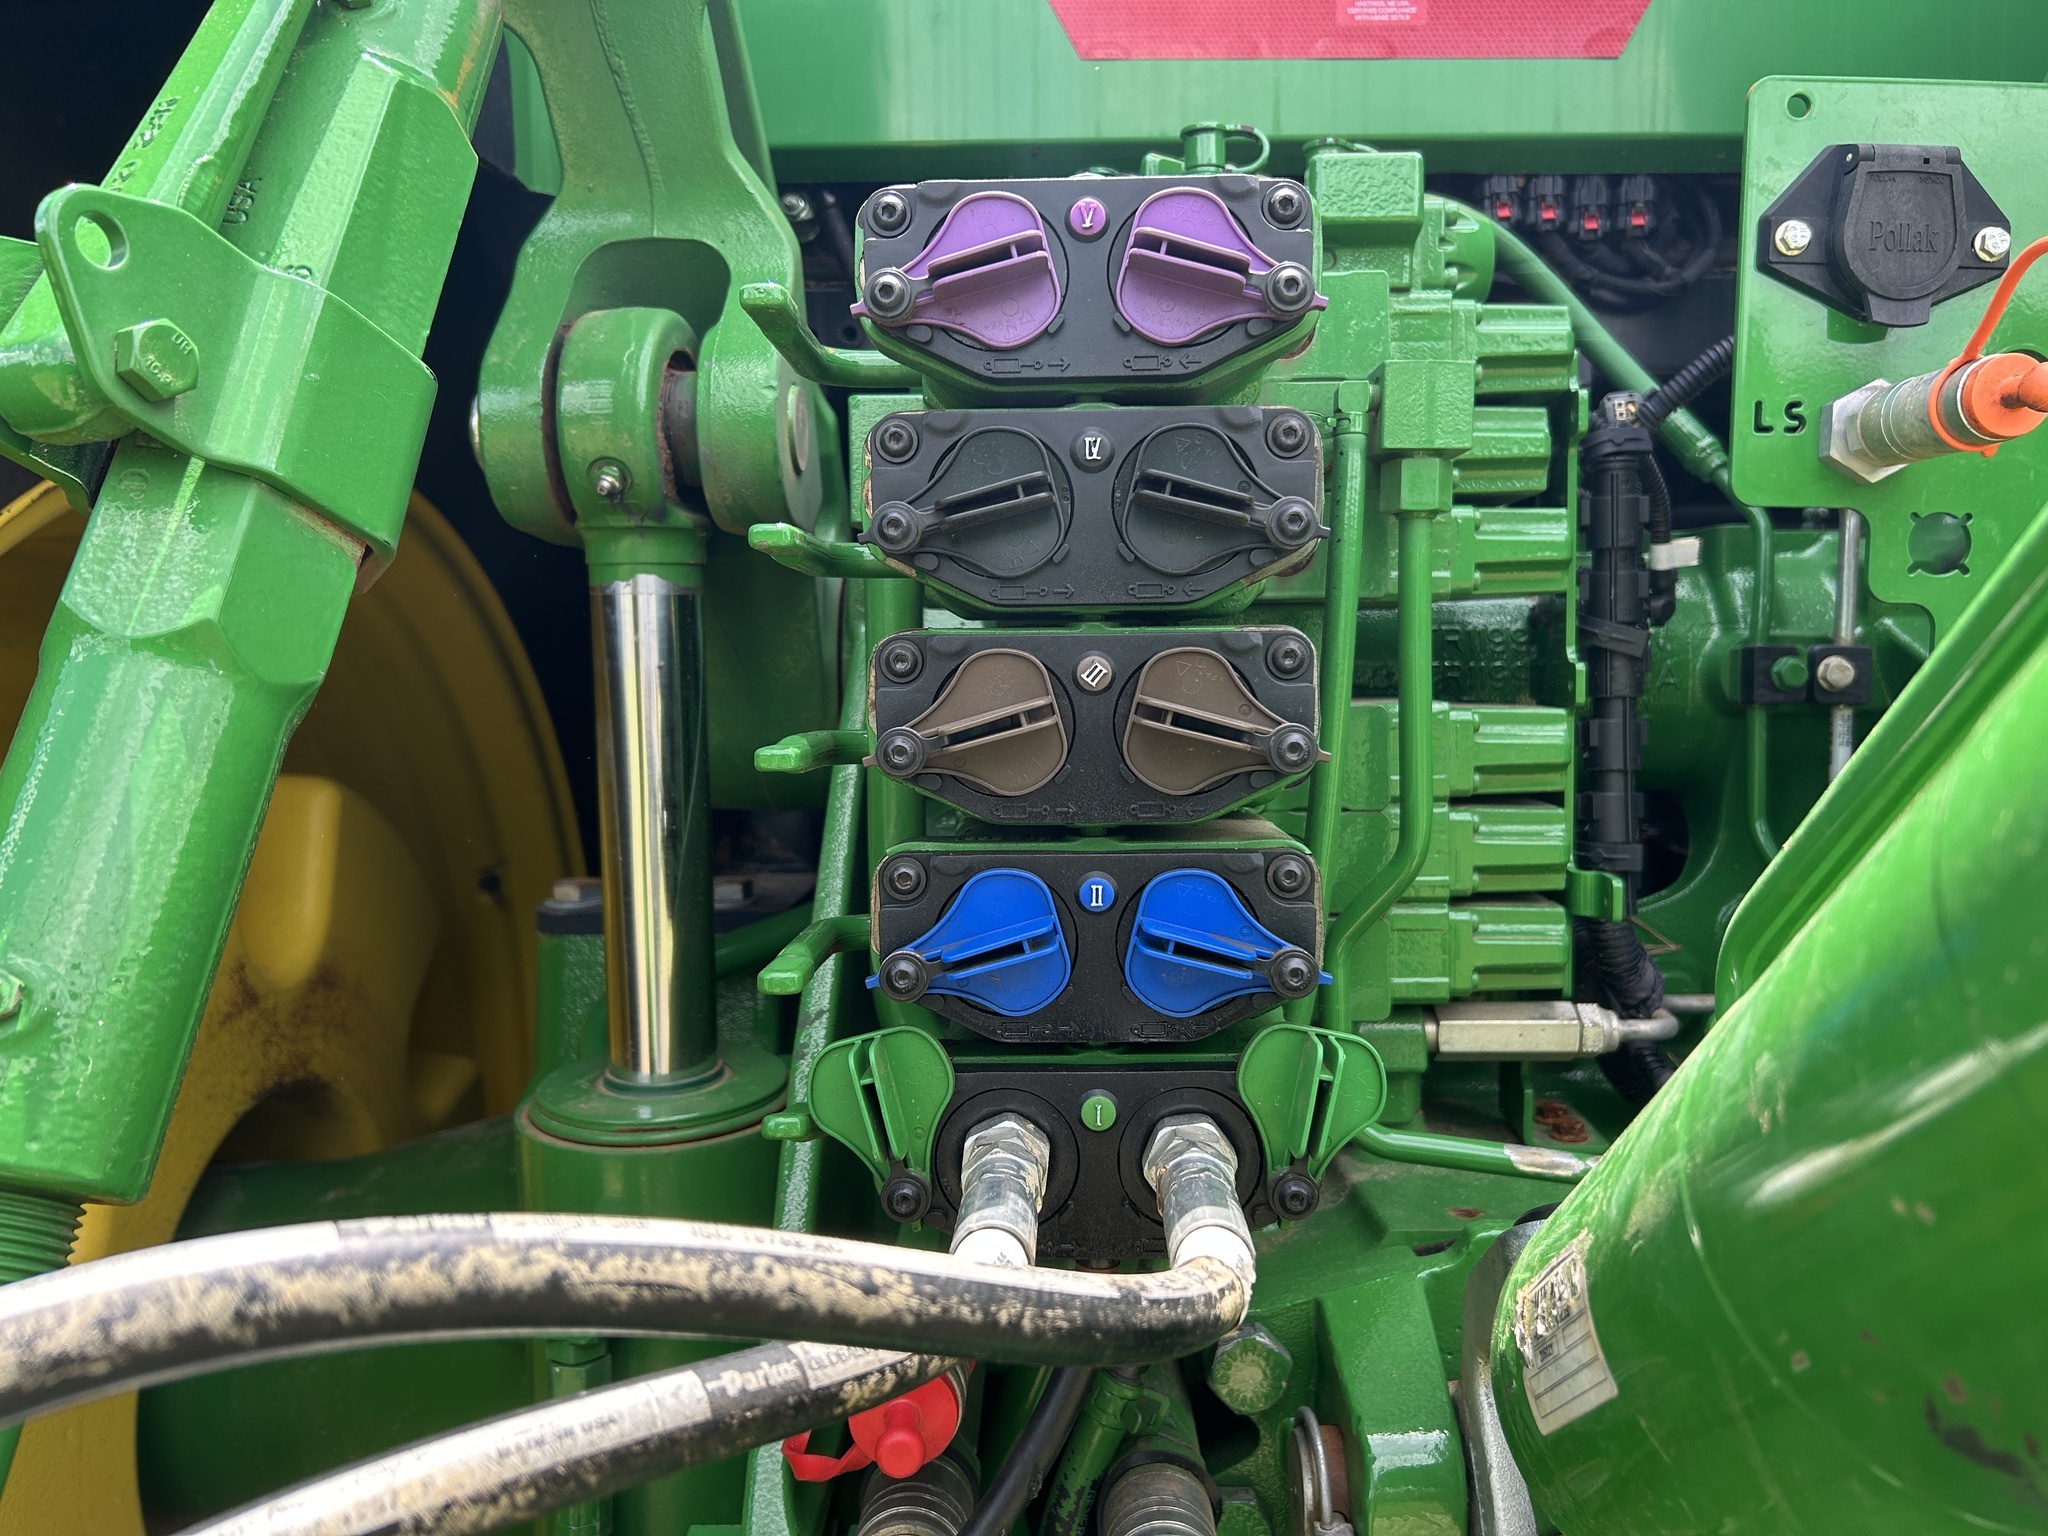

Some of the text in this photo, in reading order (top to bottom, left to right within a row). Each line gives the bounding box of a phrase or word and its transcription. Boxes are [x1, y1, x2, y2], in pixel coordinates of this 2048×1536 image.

[1868, 220, 1940, 253] Pollak
[1084, 436, 1102, 460] IV
[1080, 661, 1108, 688] III
[1090, 884, 1104, 907] II
[1094, 1103, 1103, 1127] I
